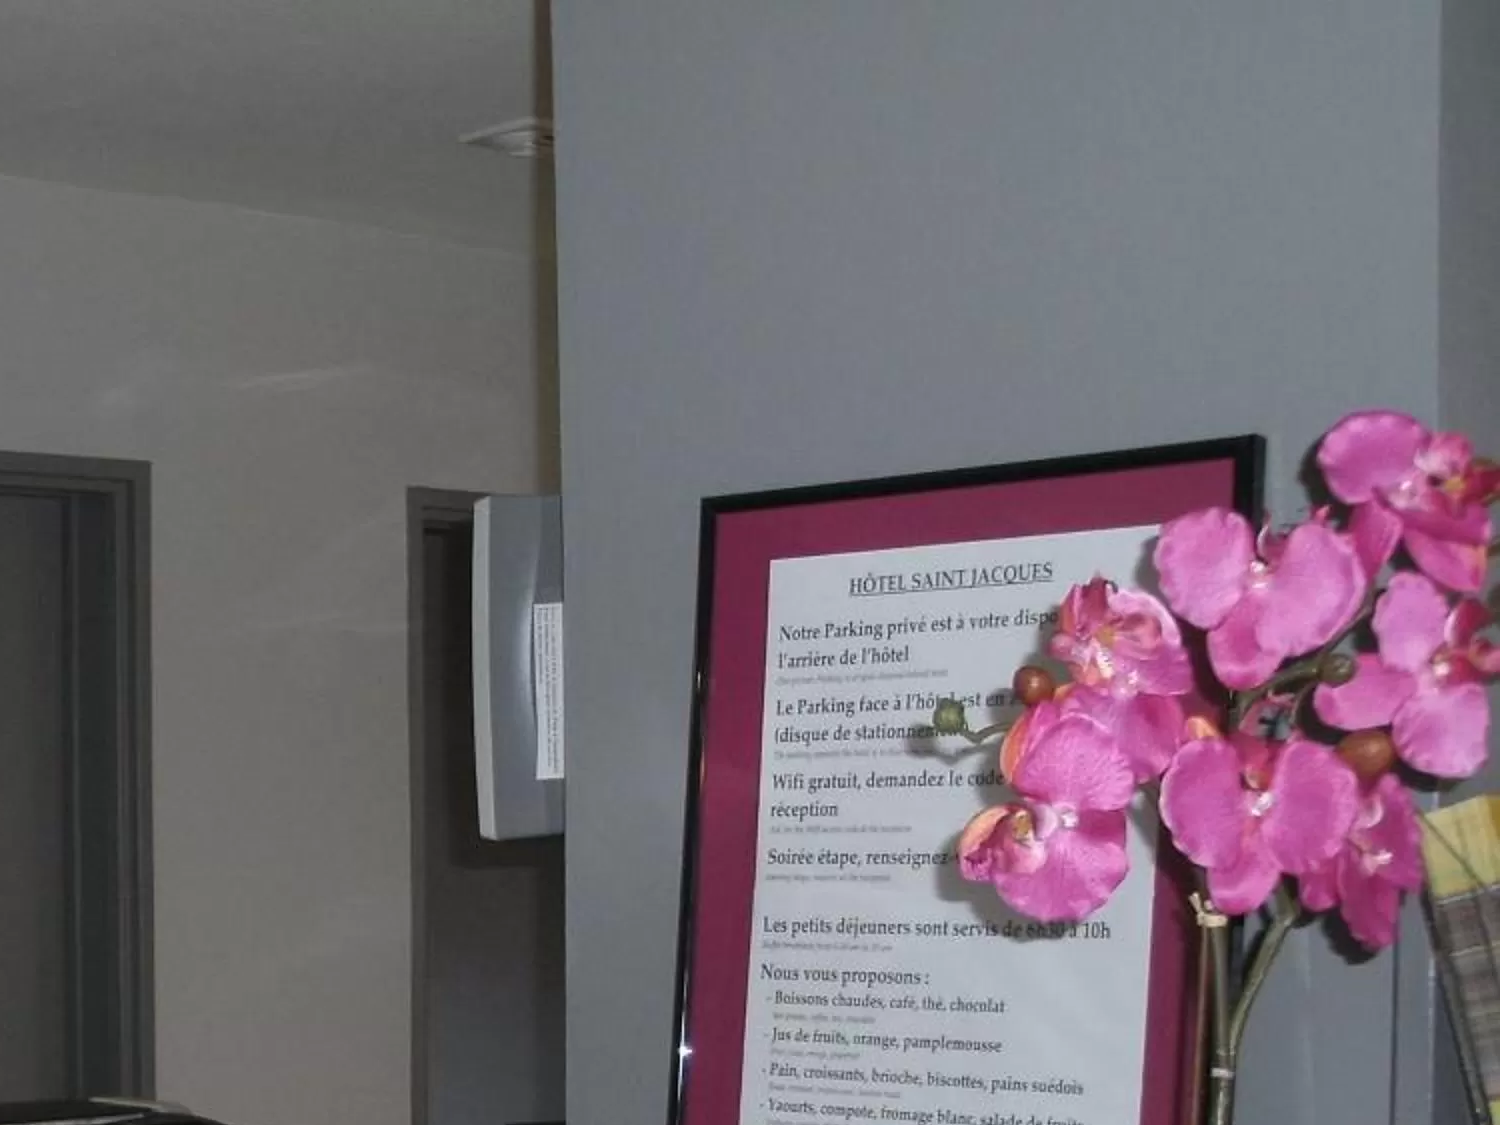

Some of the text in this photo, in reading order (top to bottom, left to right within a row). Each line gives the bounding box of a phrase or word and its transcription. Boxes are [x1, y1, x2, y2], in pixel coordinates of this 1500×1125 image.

[850, 562, 1053, 596] HÔTEL SAINT JACQUES
[780, 625, 820, 641] Notre
[825, 620, 883, 640] Parking
[887, 616, 926, 639] privé
[931, 617, 952, 633] est
[956, 614, 966, 630] à
[969, 613, 1008, 630] votre
[778, 646, 910, 669] l'arrière de l'hôtel
[777, 700, 793, 716] Le
[797, 698, 855, 718] Parking
[859, 696, 888, 712] face
[893, 696, 900, 712] à
[775, 727, 828, 744] (disque
[833, 726, 851, 741] de
[773, 768, 1005, 794] Wifi gratuit, demandez le code
[770, 801, 838, 822] réception
[767, 848, 813, 865] Soirée
[817, 848, 861, 869] étape,
[763, 916, 787, 933] Les
[791, 917, 832, 938] petits
[836, 917, 911, 940] déjeuners
[915, 919, 948, 937] sont
[952, 920, 999, 938] servis
[1003, 919, 1023, 937] de
[1081, 920, 1112, 939] 10h
[760, 964, 921, 988] Nous vous proposons
[775, 991, 1005, 1014] Boissons chaudes, café, thé, chocolat
[771, 1027, 1002, 1053] Jus de fruits, orange, pamplemousse
[769, 1063, 1084, 1096] Pain, croissants, brioche, biscottes, pains suédois
[767, 1100, 817, 1116] Yaourts,
[820, 1105, 878, 1121] compote,
